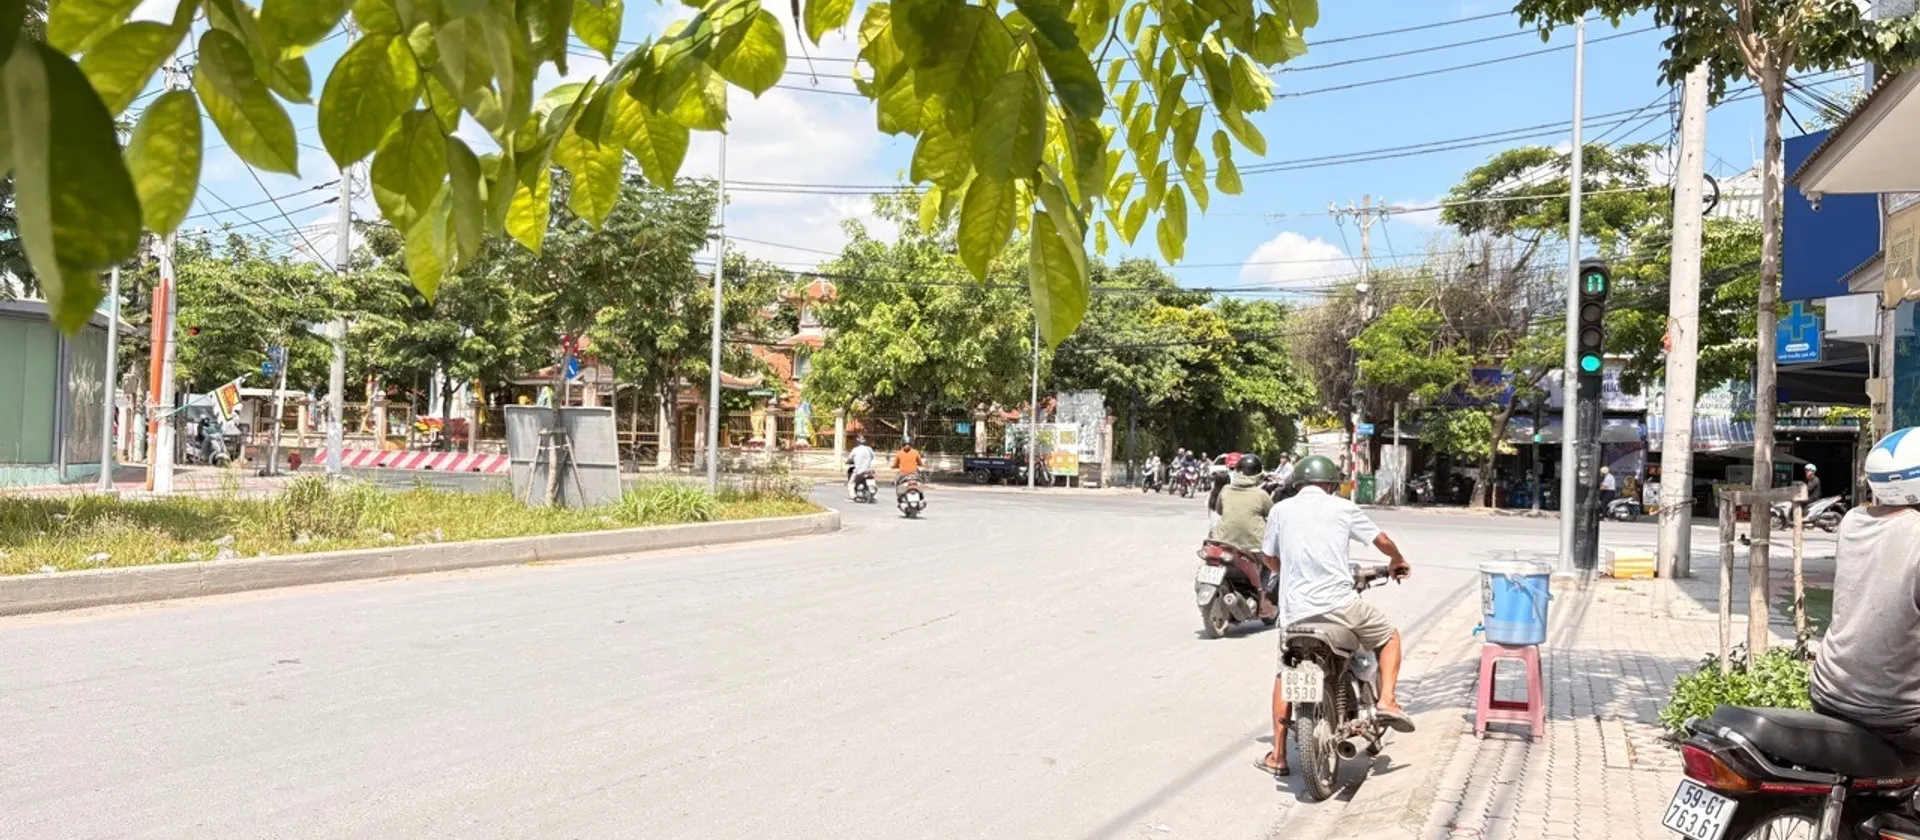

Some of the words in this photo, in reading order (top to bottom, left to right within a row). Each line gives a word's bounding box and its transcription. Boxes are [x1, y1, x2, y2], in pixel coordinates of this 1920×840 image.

[1285, 672, 1317, 686] 60-K6
[1285, 687, 1317, 700] 9530
[1682, 784, 1726, 819] 59-G1
[1666, 804, 1720, 840] 763.61
